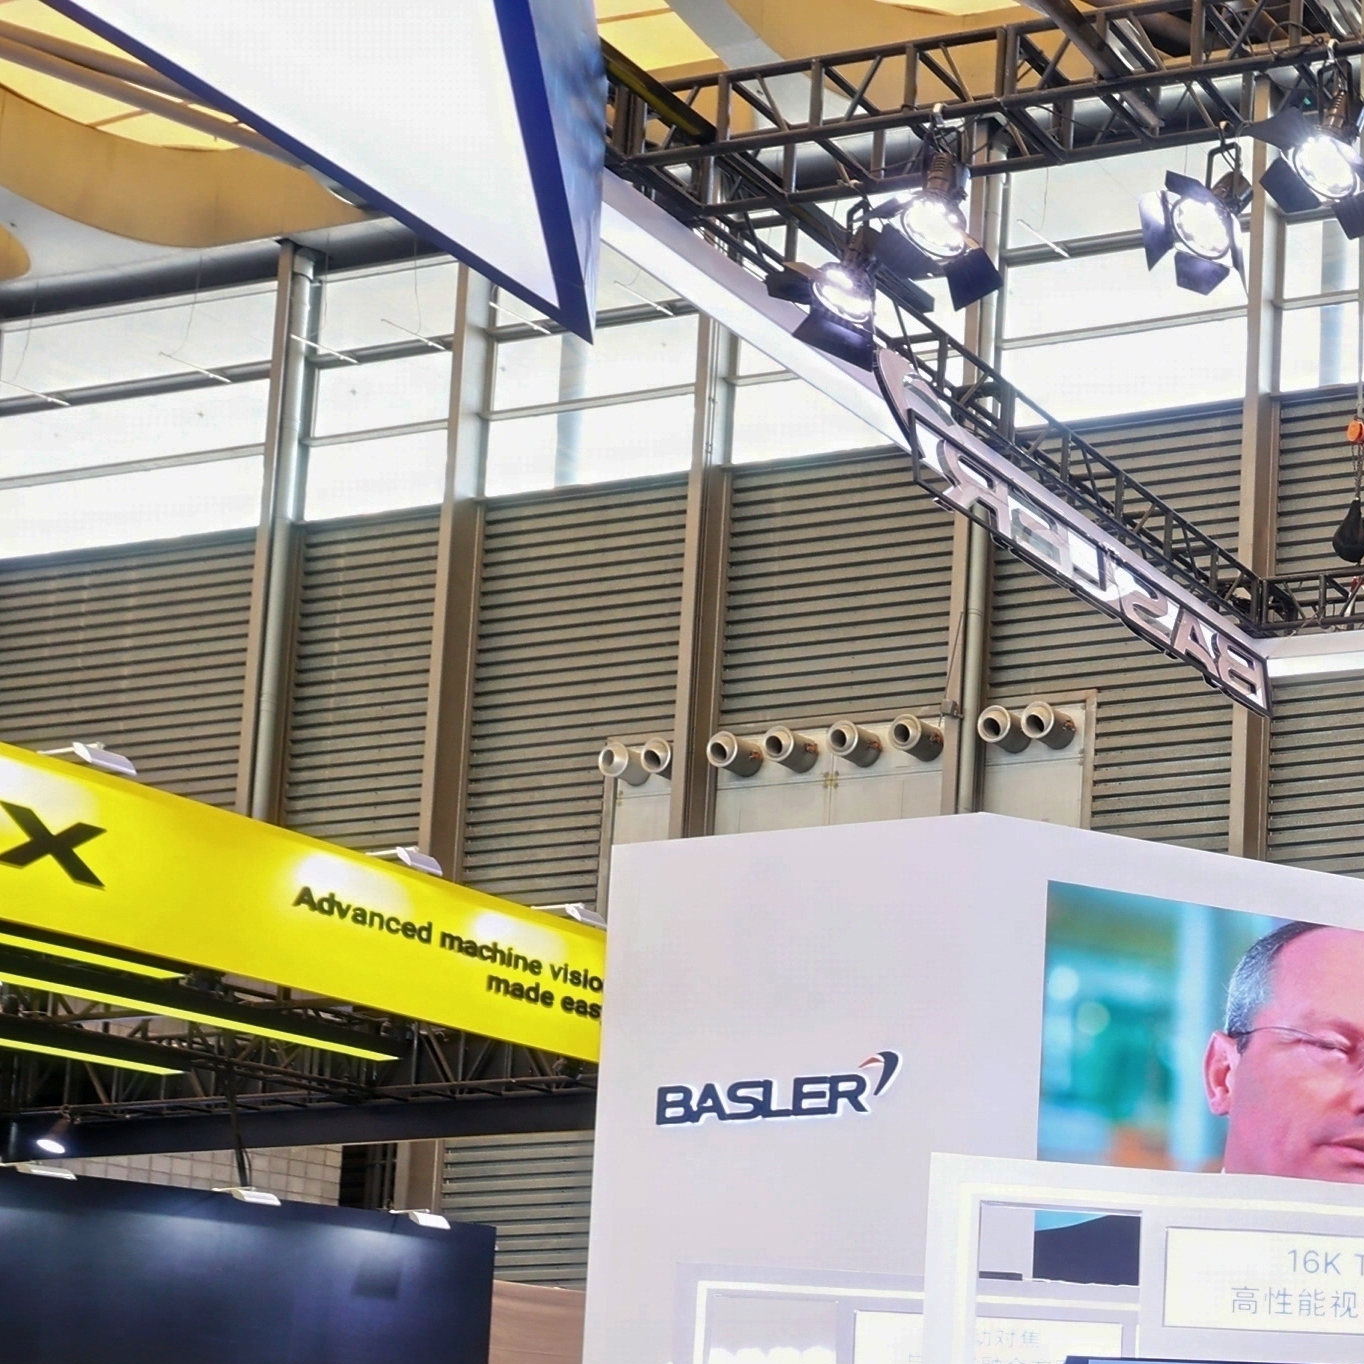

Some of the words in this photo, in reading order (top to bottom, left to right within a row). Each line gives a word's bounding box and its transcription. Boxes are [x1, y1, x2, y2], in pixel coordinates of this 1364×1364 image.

[293, 886, 433, 944] Advanced
[440, 931, 543, 975] machine
[550, 963, 603, 994] visio
[487, 974, 554, 1008] made
[562, 995, 602, 1020] eas
[656, 1073, 869, 1126] BASLER
[1287, 1249, 1342, 1276] 16K
